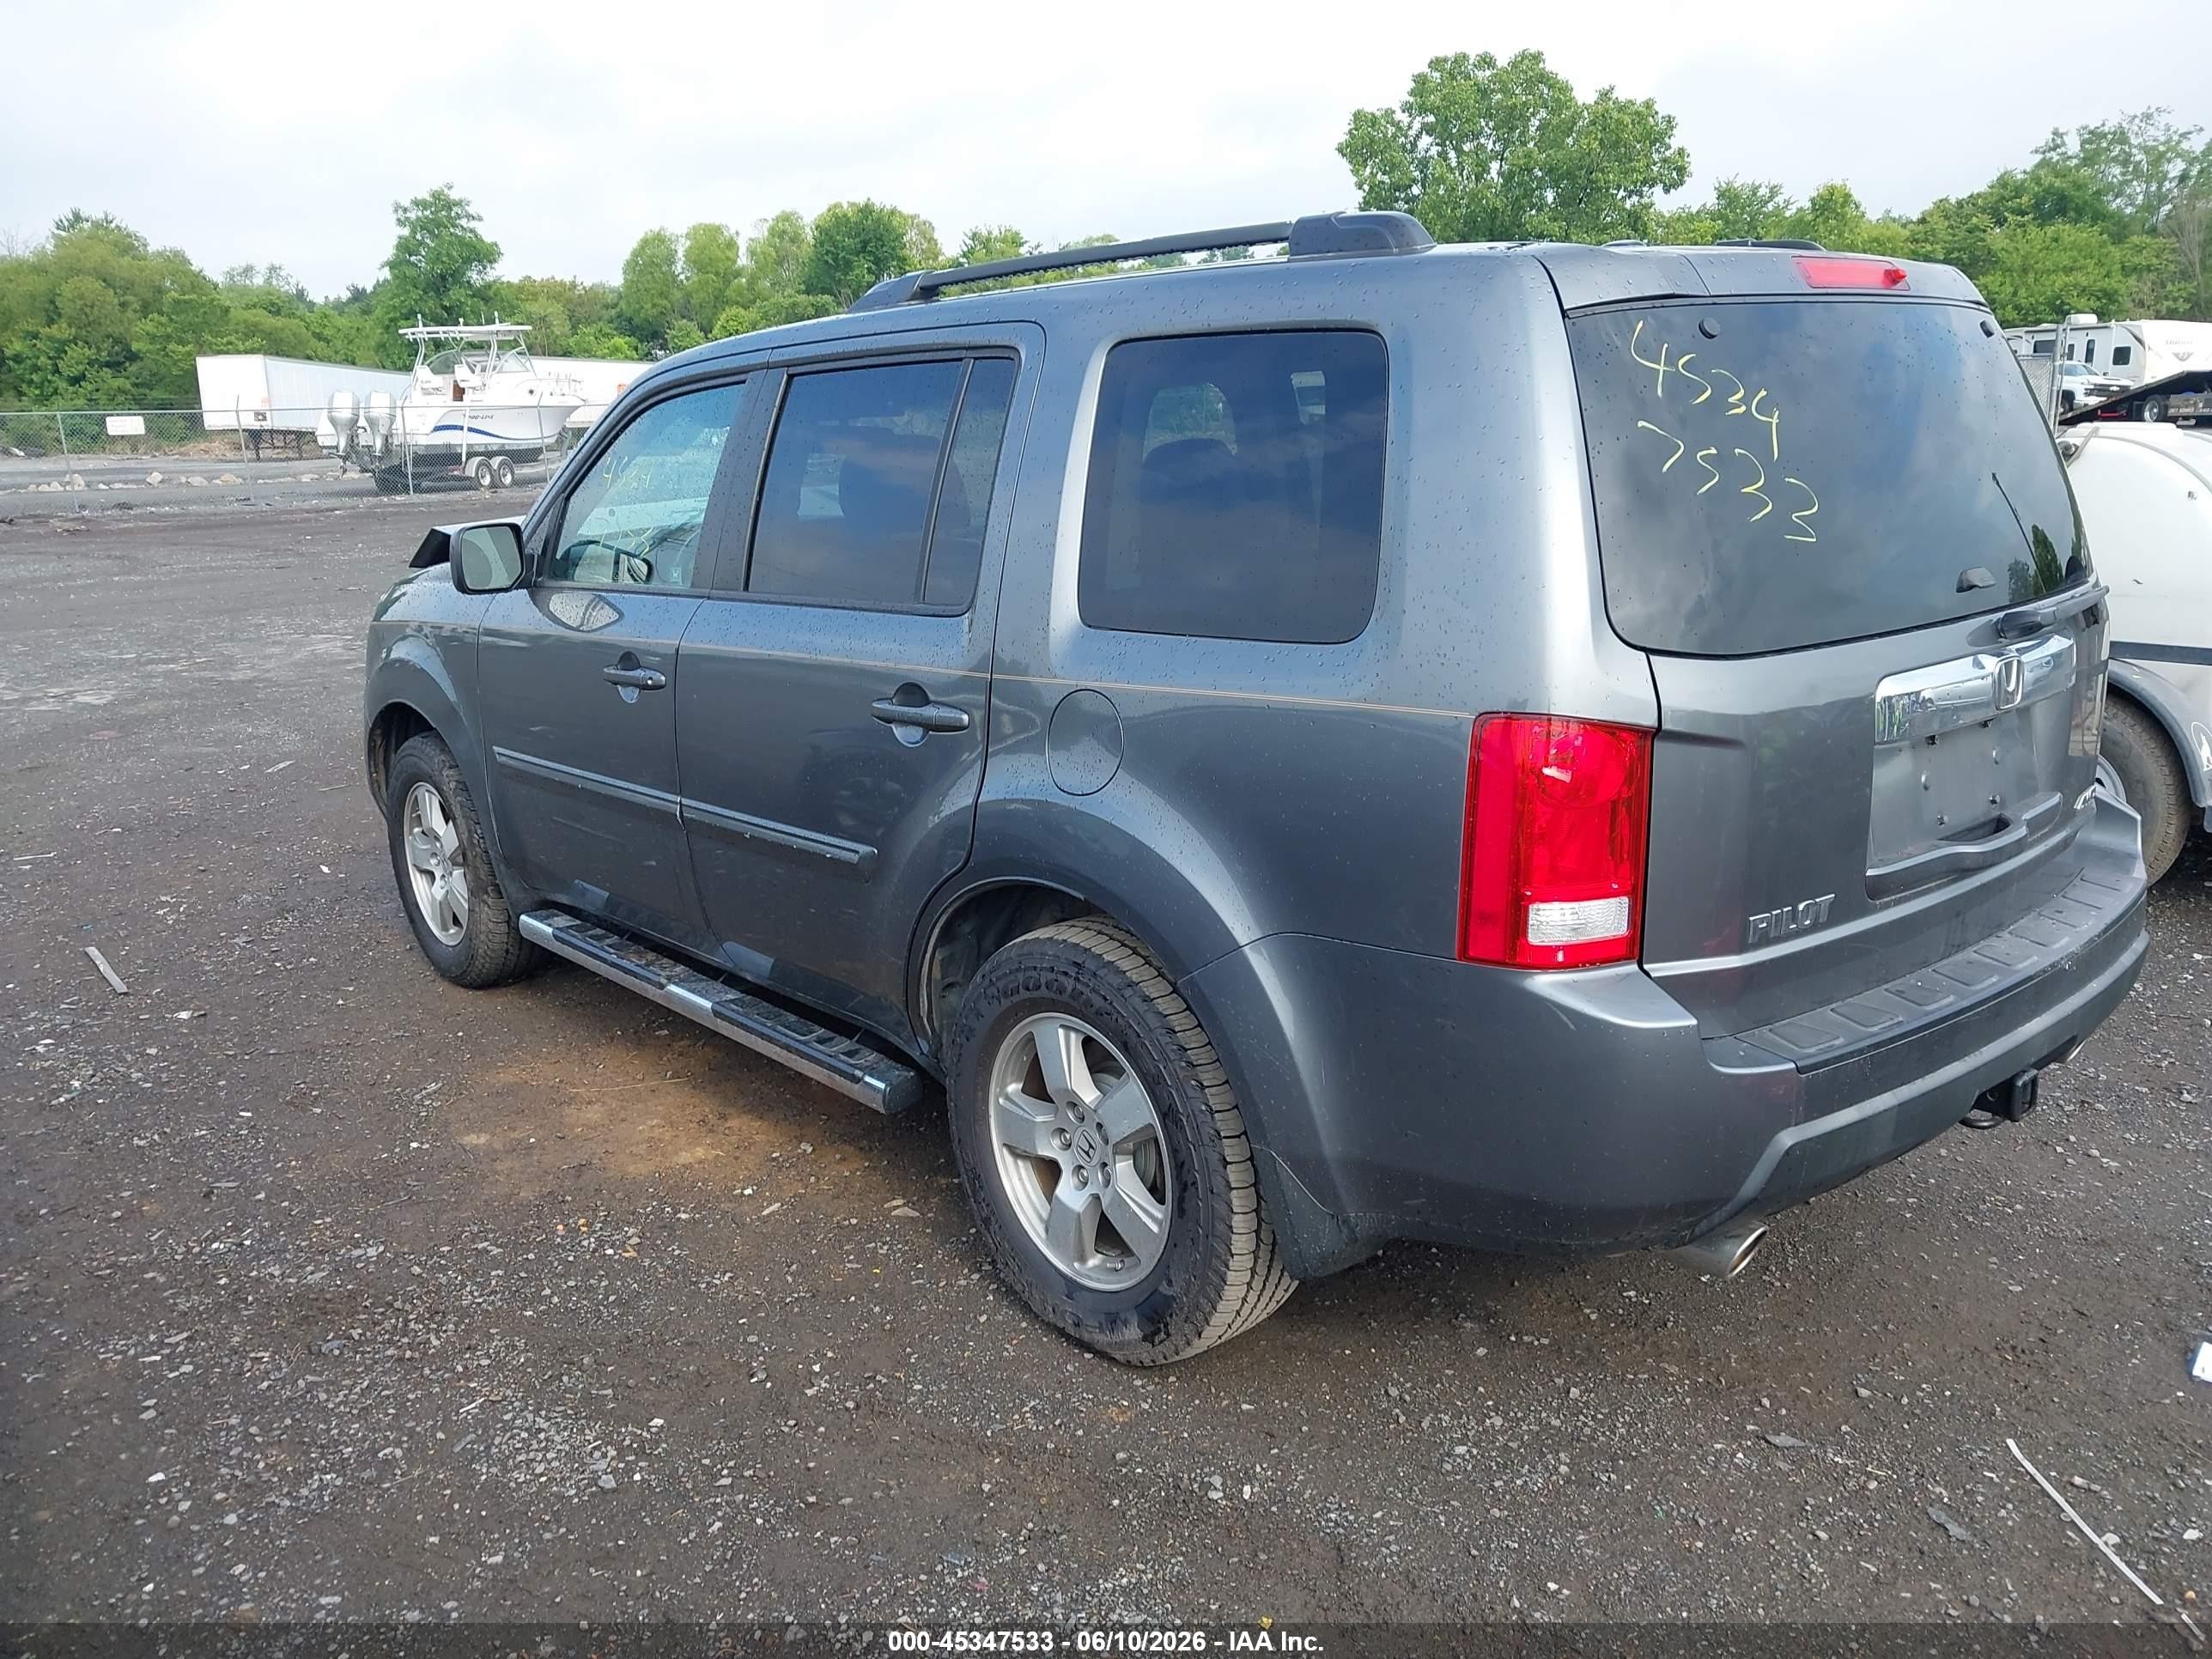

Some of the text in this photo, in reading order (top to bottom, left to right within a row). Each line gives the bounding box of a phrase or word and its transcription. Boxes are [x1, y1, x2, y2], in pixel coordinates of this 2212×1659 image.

[1631, 319, 1781, 463] 4534
[1637, 419, 1819, 543] 7533
[1747, 893, 1836, 944] PILOT
